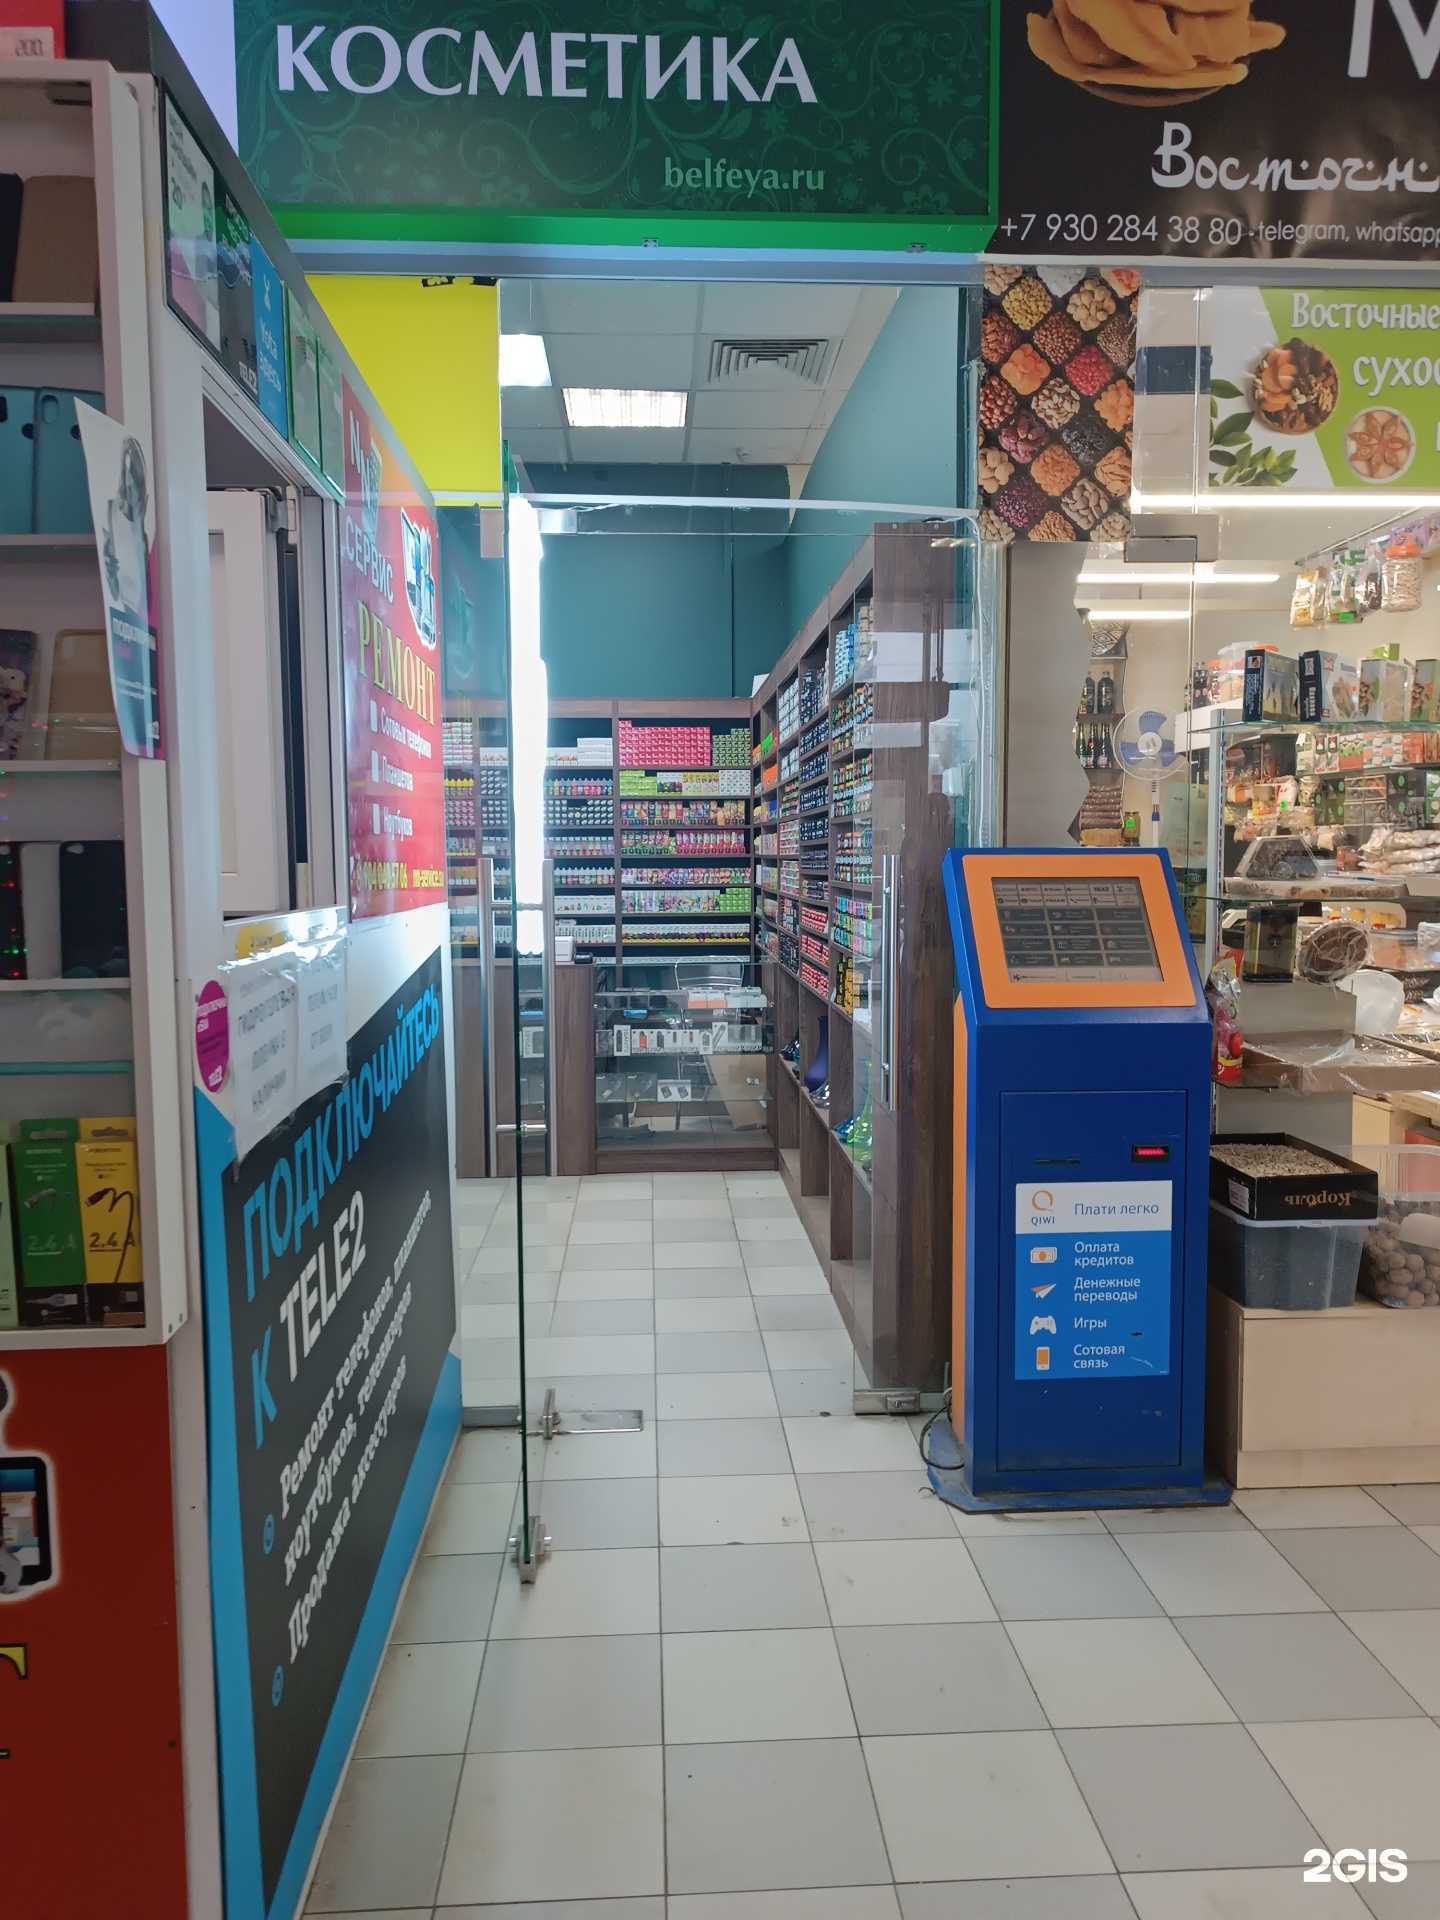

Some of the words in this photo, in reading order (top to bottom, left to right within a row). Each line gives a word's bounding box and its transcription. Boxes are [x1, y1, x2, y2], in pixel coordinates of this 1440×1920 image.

[276, 24, 818, 104] КОСМЕТИКА
[664, 156, 825, 199] belfeya.ru
[1000, 213, 1037, 241] +7
[1046, 213, 1098, 242] 930
[1106, 214, 1159, 242] 284
[1166, 215, 1200, 243] 38
[1208, 217, 1242, 246] 80
[1258, 219, 1350, 244] telegram,
[1291, 292, 1440, 330] Восточные
[1352, 355, 1440, 397] сухо
[345, 514, 394, 604] СЕРВИС
[358, 599, 436, 726] РЕМОНТ
[243, 983, 440, 1302] ПОДКЛЮЧАЙТЕСЬ
[1074, 1203, 1116, 1216] Плати
[1120, 1203, 1160, 1215] легко
[1284, 1189, 1352, 1208] Король
[1031, 1216, 1055, 1226] QIWI
[1074, 1240, 1120, 1253] Оплата
[1074, 1255, 1135, 1269] кредитов
[1073, 1276, 1141, 1291] Денежные
[1074, 1291, 1138, 1304] переводы
[250, 1327, 277, 1450] К
[279, 1190, 367, 1383] TELE2
[1073, 1316, 1107, 1331] Игры
[1073, 1343, 1125, 1356] Сотовая
[1073, 1358, 1109, 1369] связь
[279, 1386, 335, 1520] Ремонт
[288, 1496, 350, 1665] Продажа
